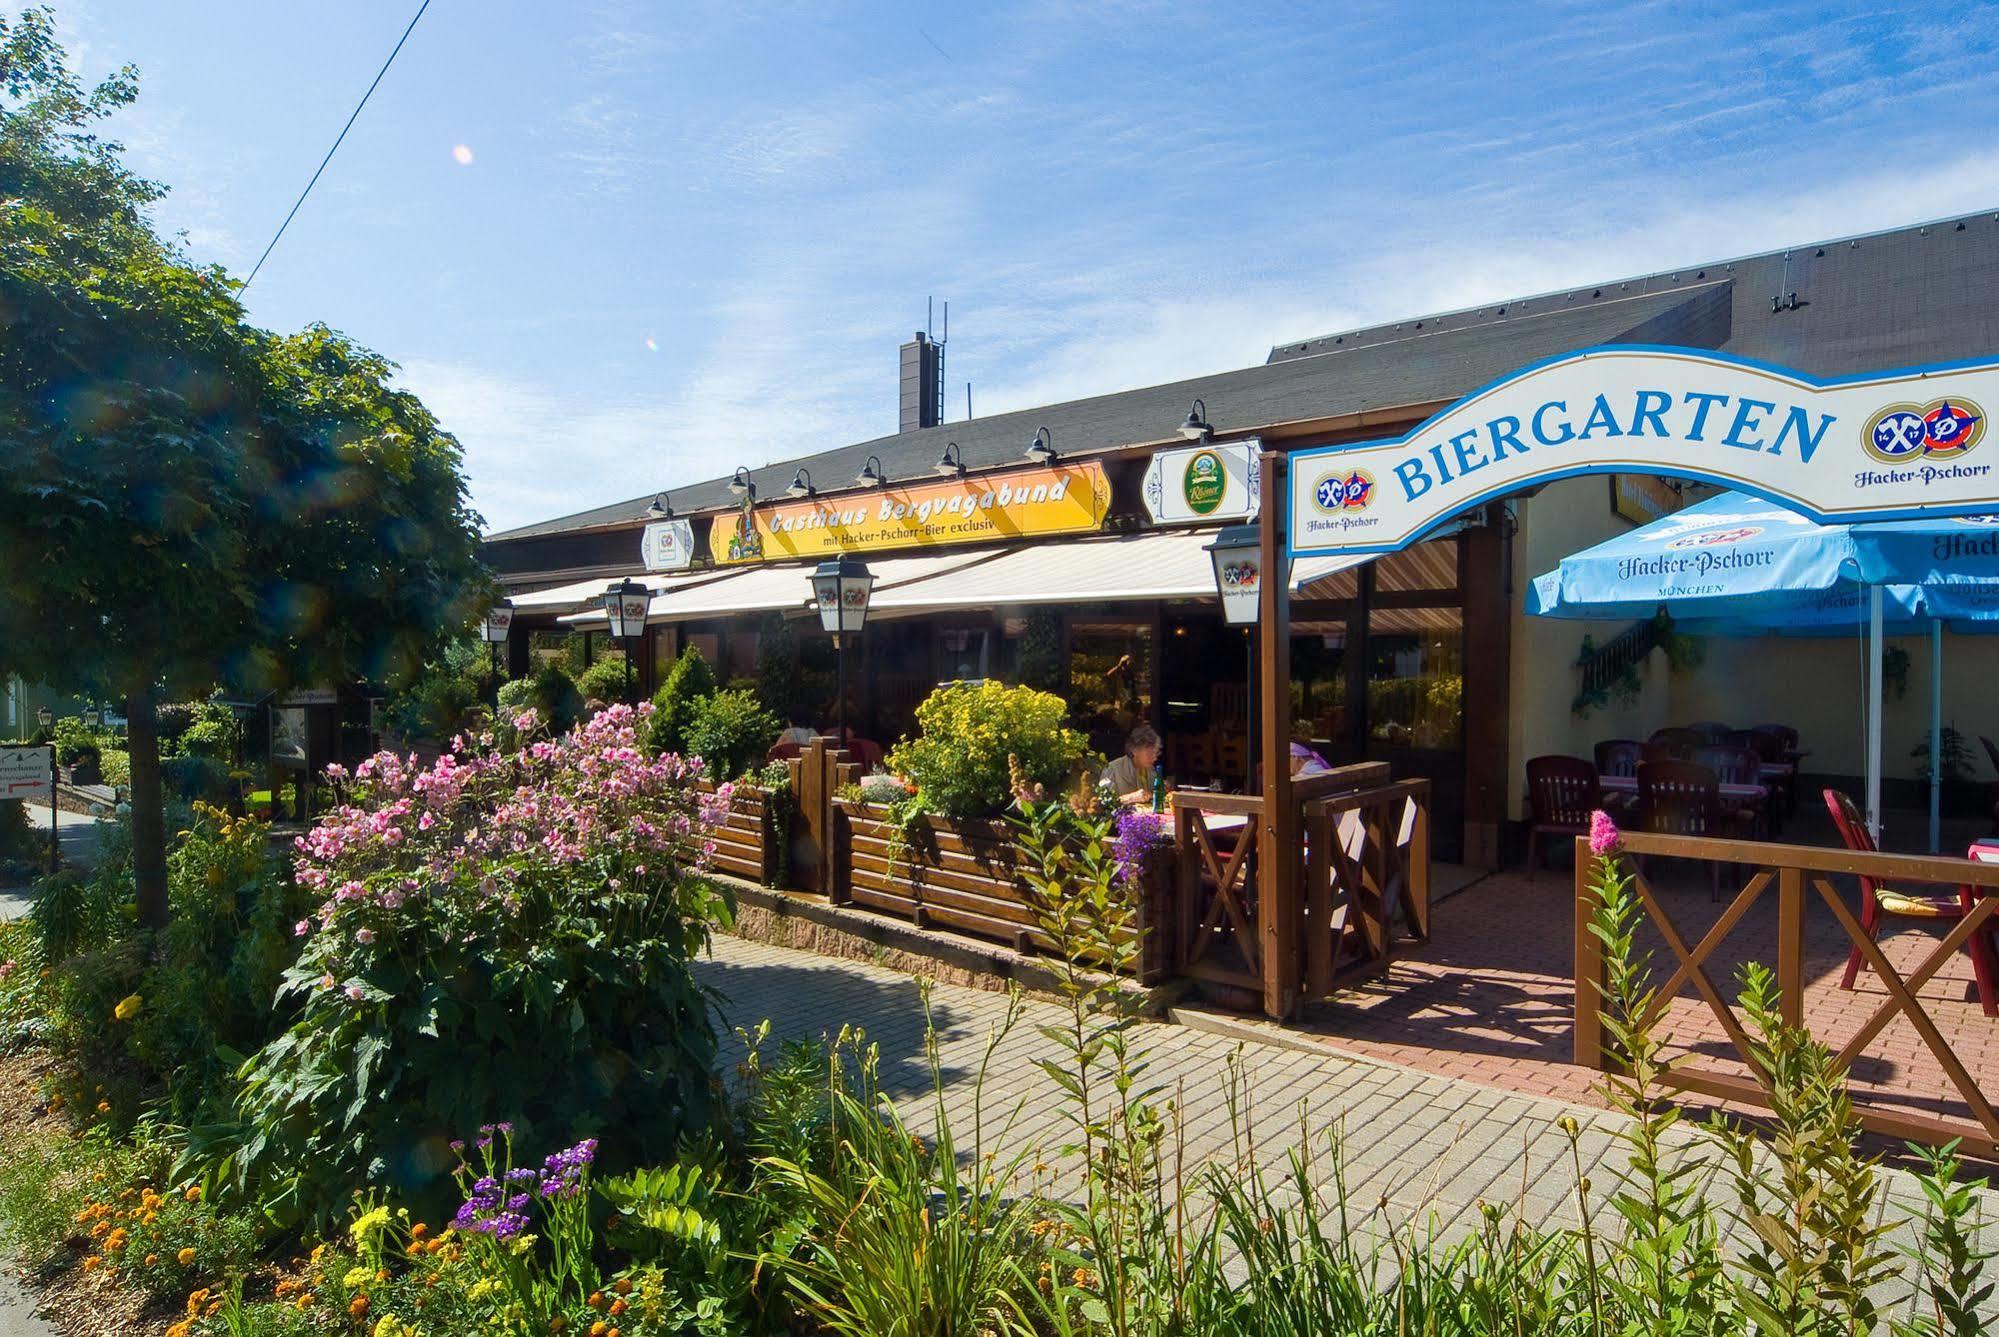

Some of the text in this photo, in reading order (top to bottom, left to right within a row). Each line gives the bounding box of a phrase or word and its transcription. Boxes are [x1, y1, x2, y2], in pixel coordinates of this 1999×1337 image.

[1392, 390, 1837, 503] BIERGARTEN
[1854, 464, 1991, 489] Hacker-Pschorr
[769, 474, 1072, 534] Gasthaus Bergvagabund
[823, 518, 995, 547] mit Hacker-Pschorr-Bier exclusiv
[1306, 517, 1379, 533] Hacker-Pschorr
[1618, 548, 1776, 581] Hacker-Pschorr
[1656, 584, 1725, 597] MÜNCHEN
